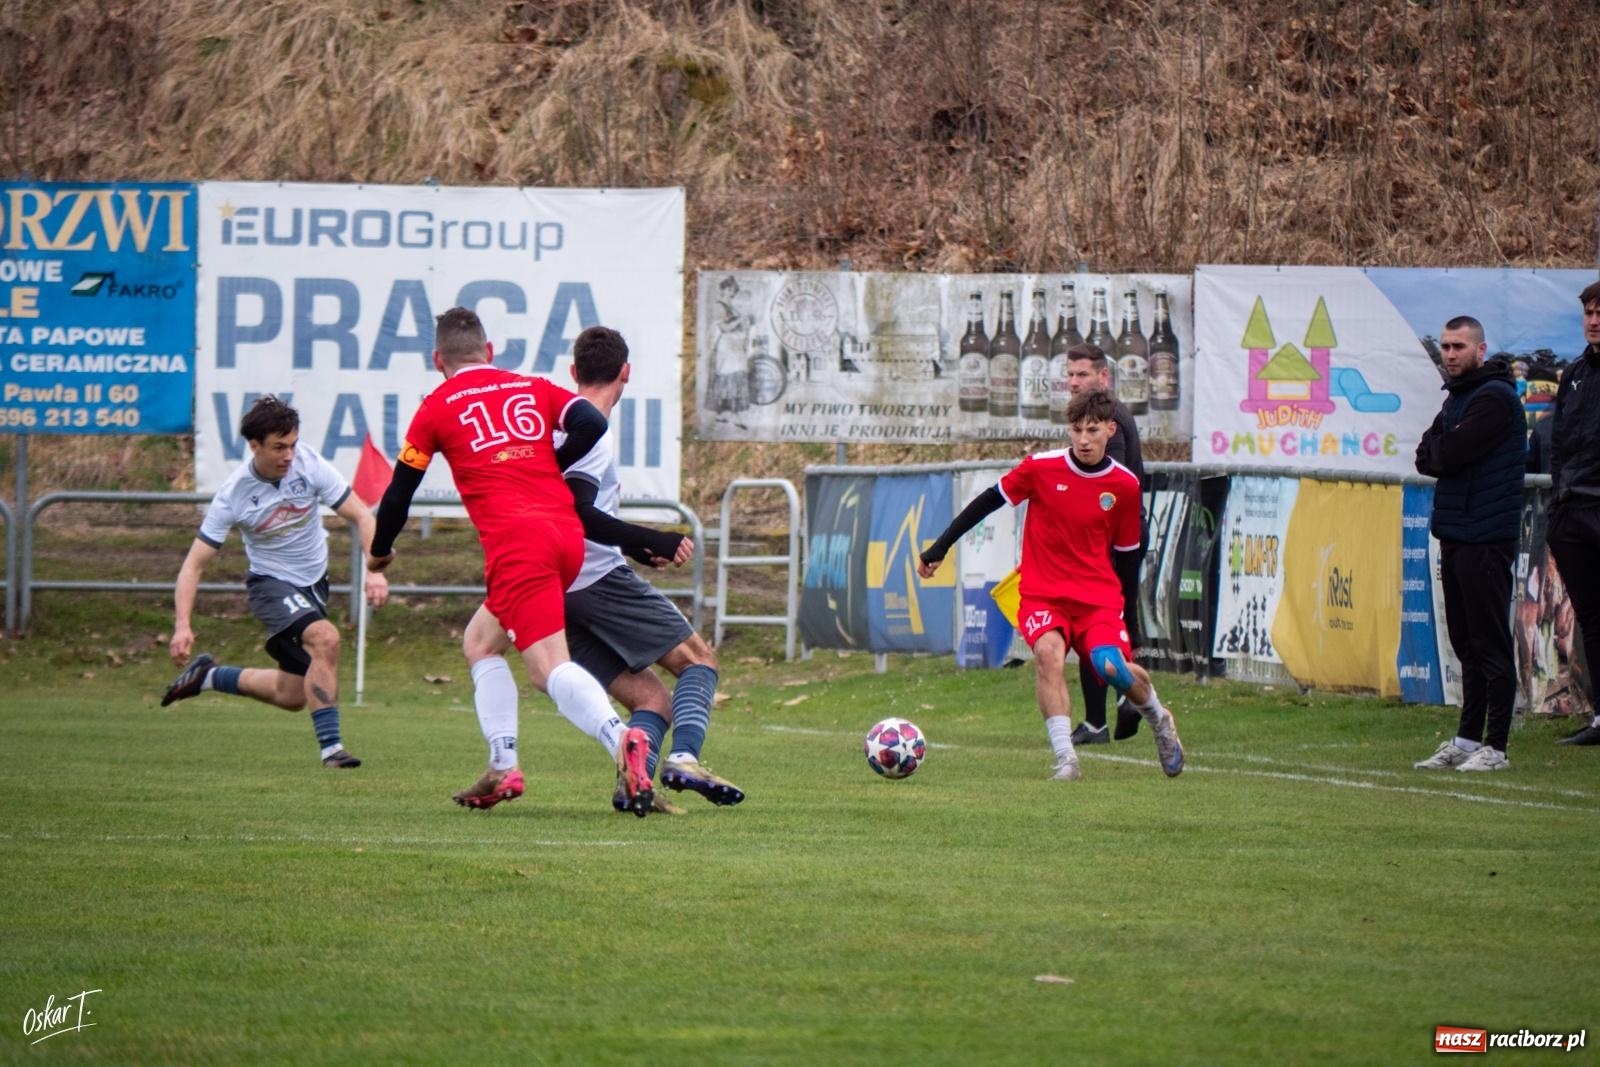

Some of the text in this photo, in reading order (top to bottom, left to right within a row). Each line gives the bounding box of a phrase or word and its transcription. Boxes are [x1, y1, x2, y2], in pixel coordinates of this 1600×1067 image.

[0, 188, 191, 252] RZWI
[107, 284, 177, 299] FAKRO
[31, 327, 146, 347] PAPOWE
[10, 352, 188, 374] CERAMICZNA
[84, 384, 101, 403] II
[108, 384, 139, 403] 60
[44, 408, 88, 427] 213
[95, 407, 140, 428] 540
[784, 403, 953, 418] MY PIWO TWORZYMY
[458, 393, 546, 453] 16
[780, 424, 816, 437] INNI
[819, 424, 841, 438] JE
